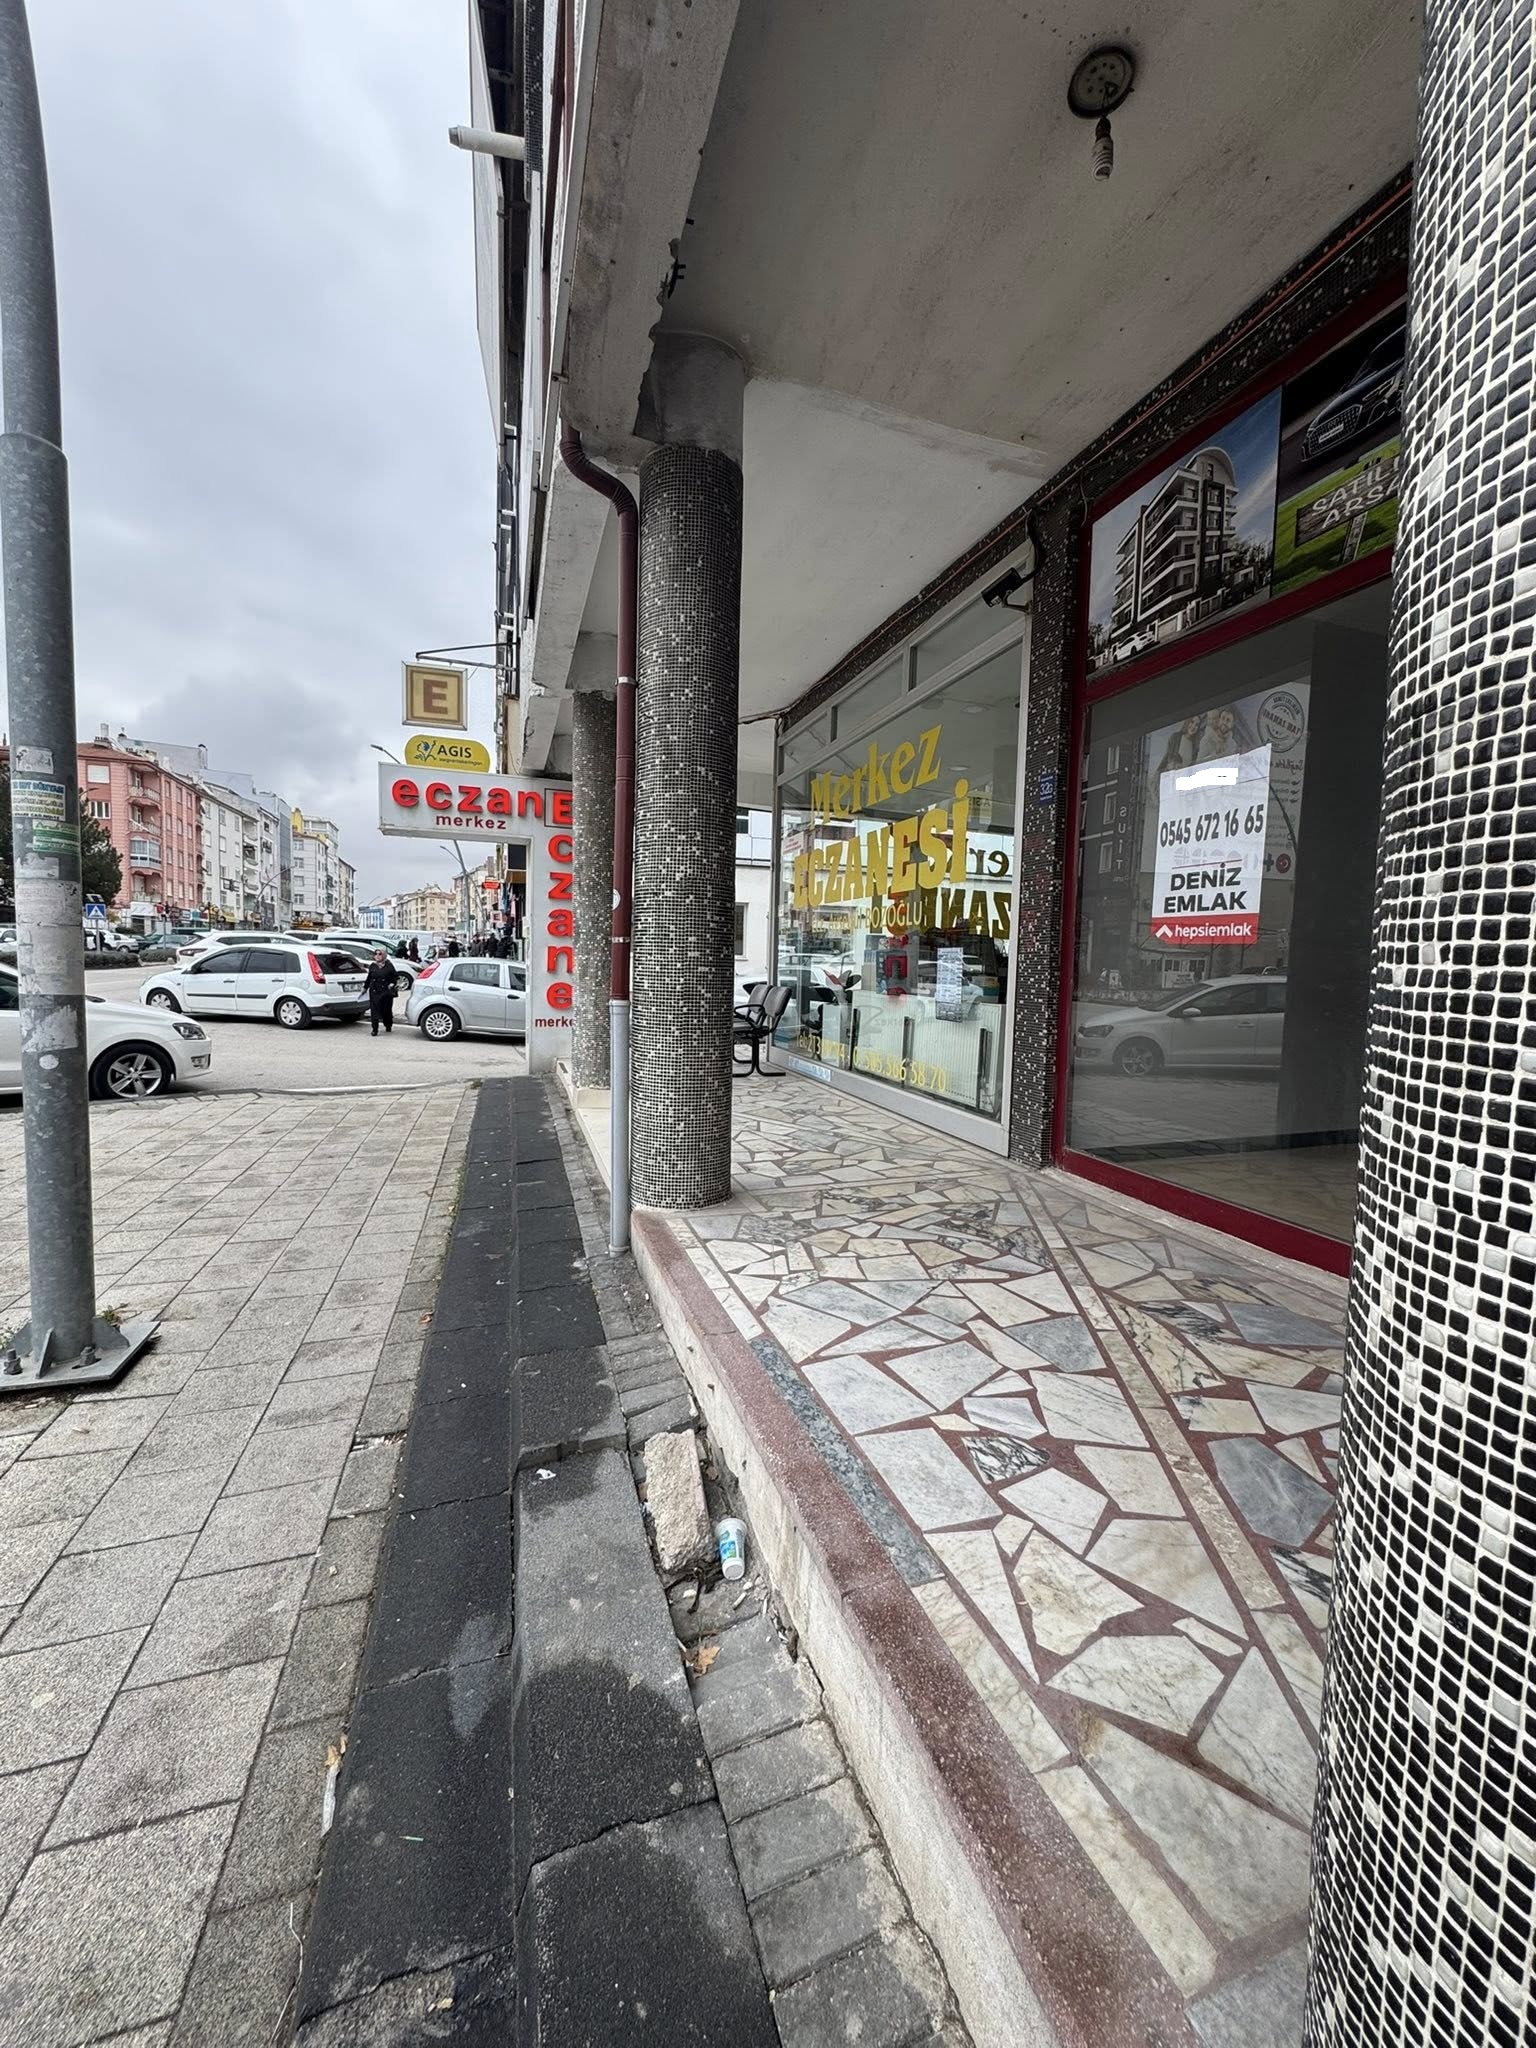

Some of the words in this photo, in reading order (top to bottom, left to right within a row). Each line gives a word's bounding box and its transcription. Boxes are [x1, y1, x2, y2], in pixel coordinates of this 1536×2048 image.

[1322, 475, 1400, 529] ARSA
[423, 679, 448, 715] E
[437, 745, 472, 758] AGIS
[810, 724, 942, 831] Merkez
[435, 815, 507, 830] merkez
[1160, 818, 1191, 848] 0545
[1195, 812, 1220, 842] 672
[1224, 808, 1239, 837] 16
[1244, 804, 1264, 835] 65
[793, 778, 970, 909] ECZANESİ
[1170, 862, 1242, 891] DENİZ
[1163, 891, 1248, 914] EMLAK
[1174, 922, 1253, 940] hepsiemlak
